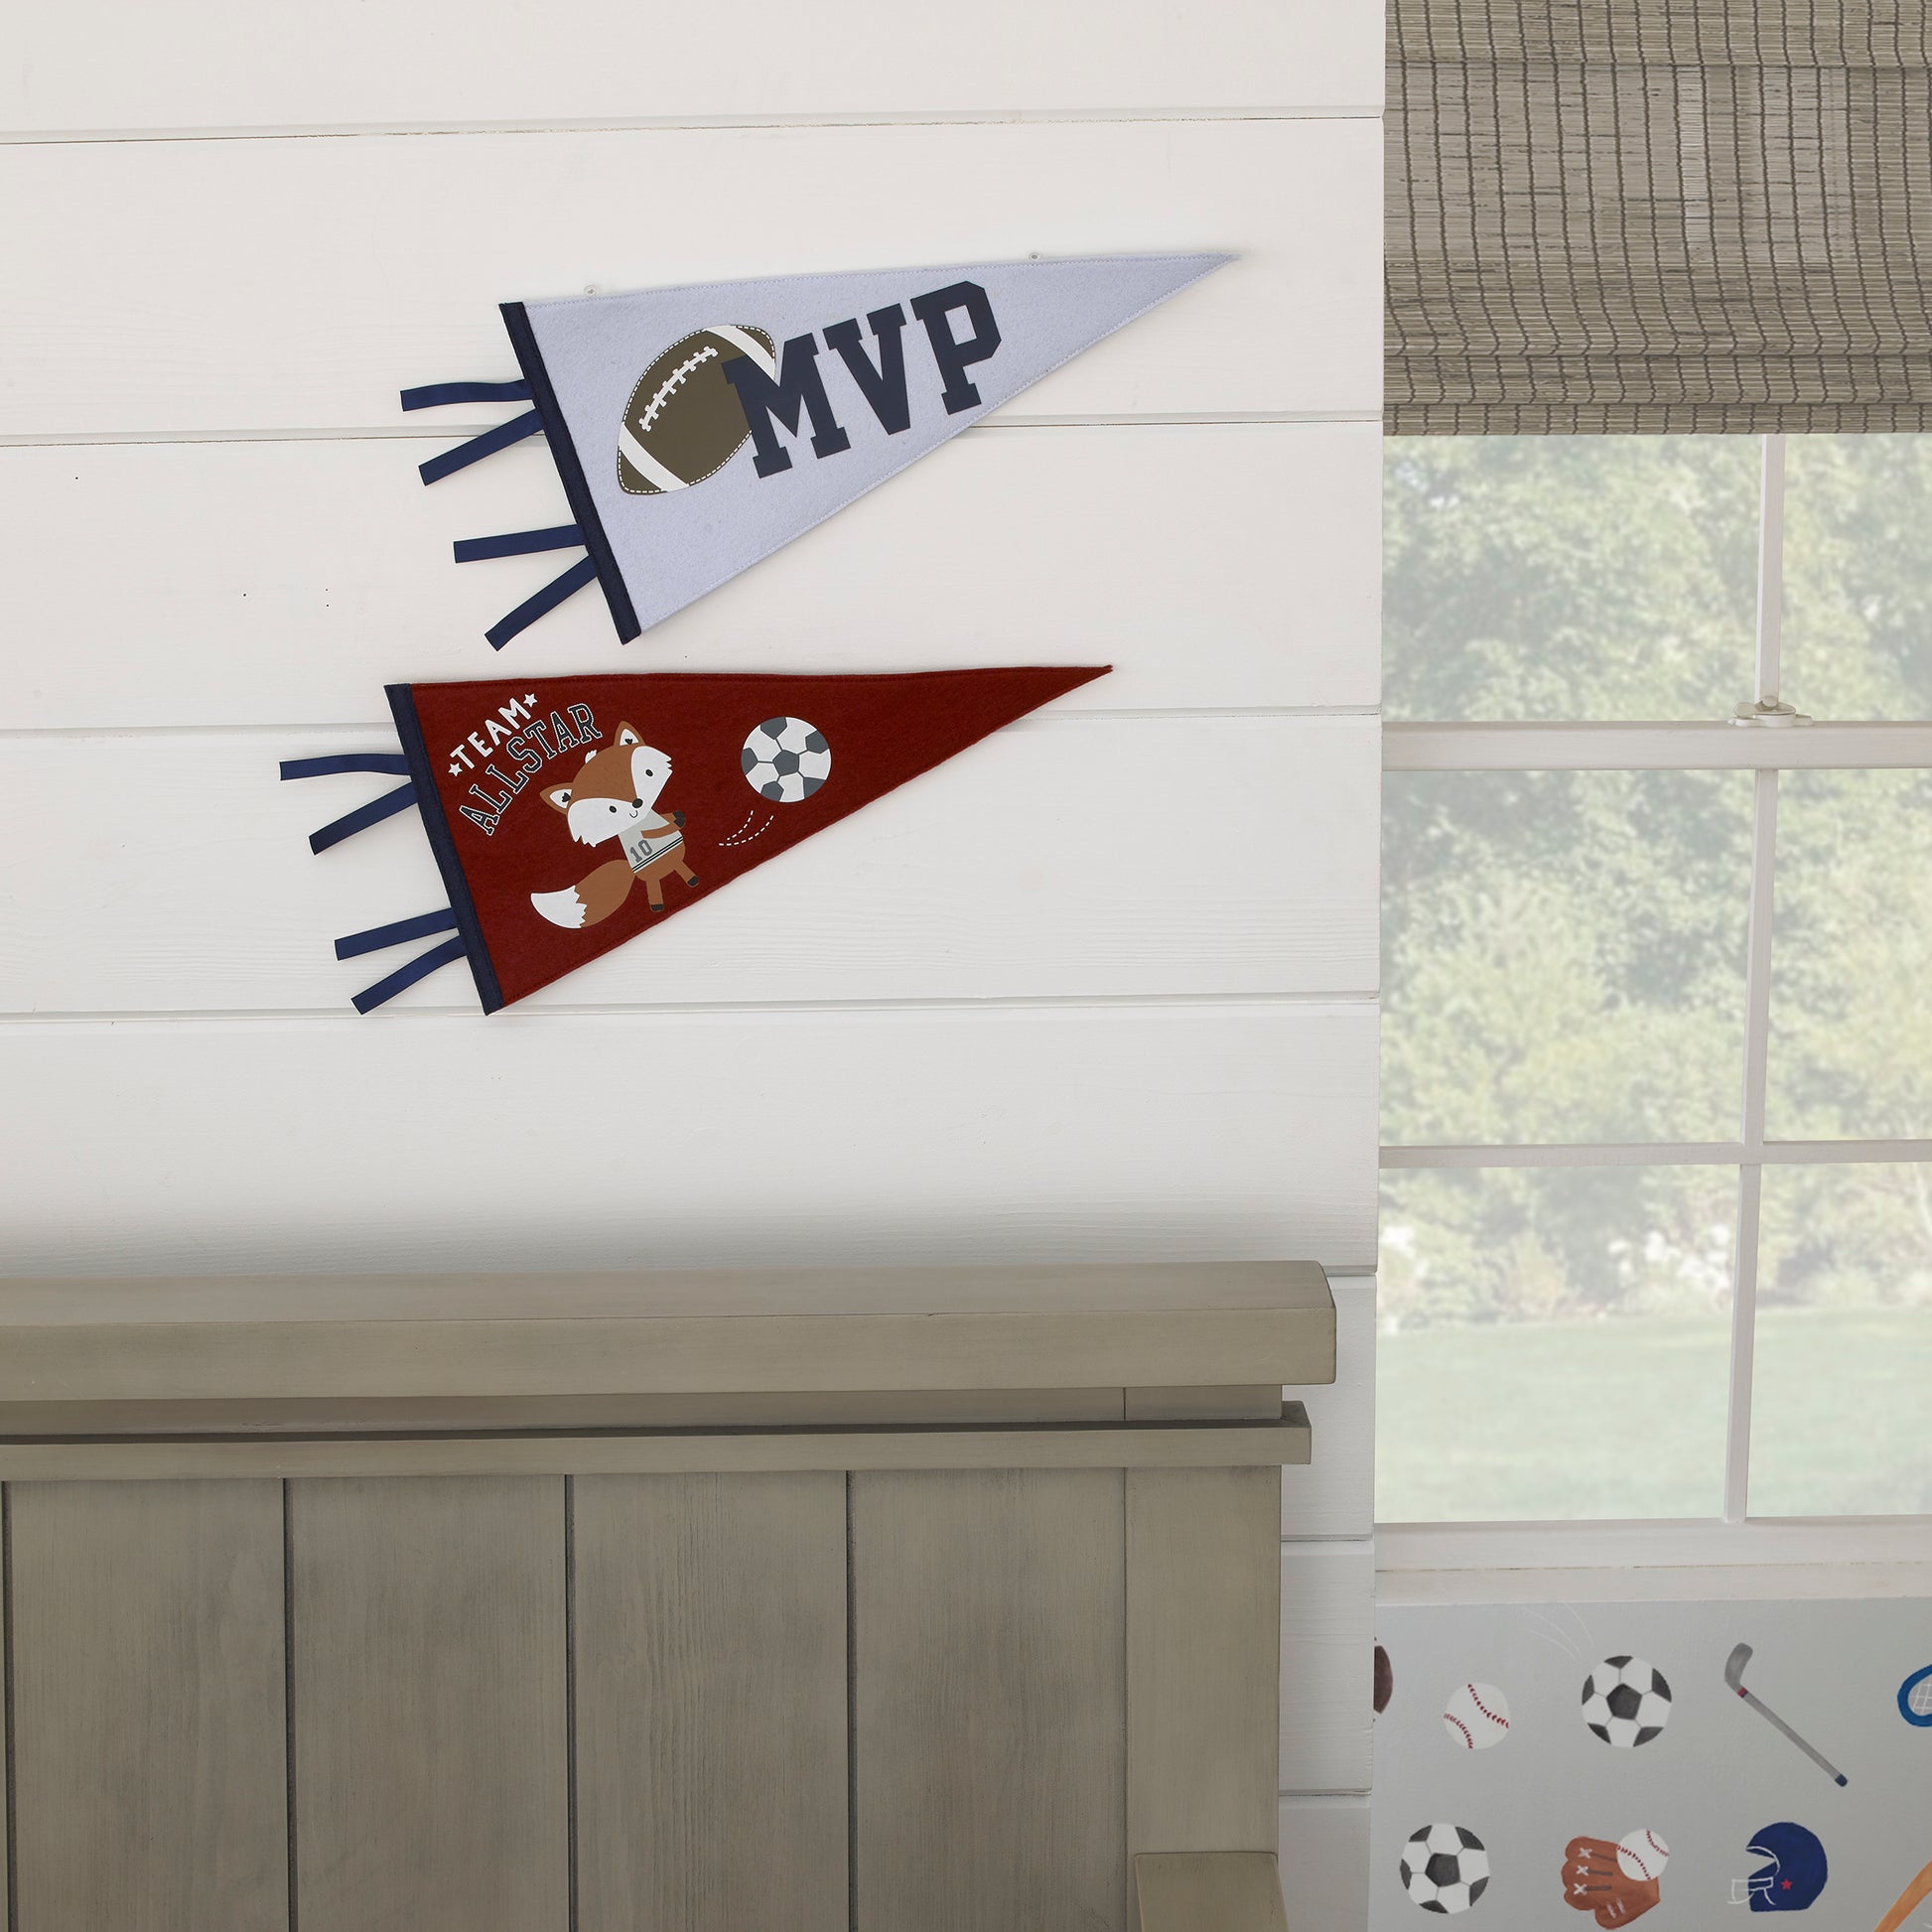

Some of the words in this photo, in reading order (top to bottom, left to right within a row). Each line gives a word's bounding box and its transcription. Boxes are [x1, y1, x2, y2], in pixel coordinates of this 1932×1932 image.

[721, 280, 1002, 479] MVP
[449, 697, 532, 769] TEAM
[459, 703, 603, 836] ALLSTAR
[629, 839, 653, 863] 10
